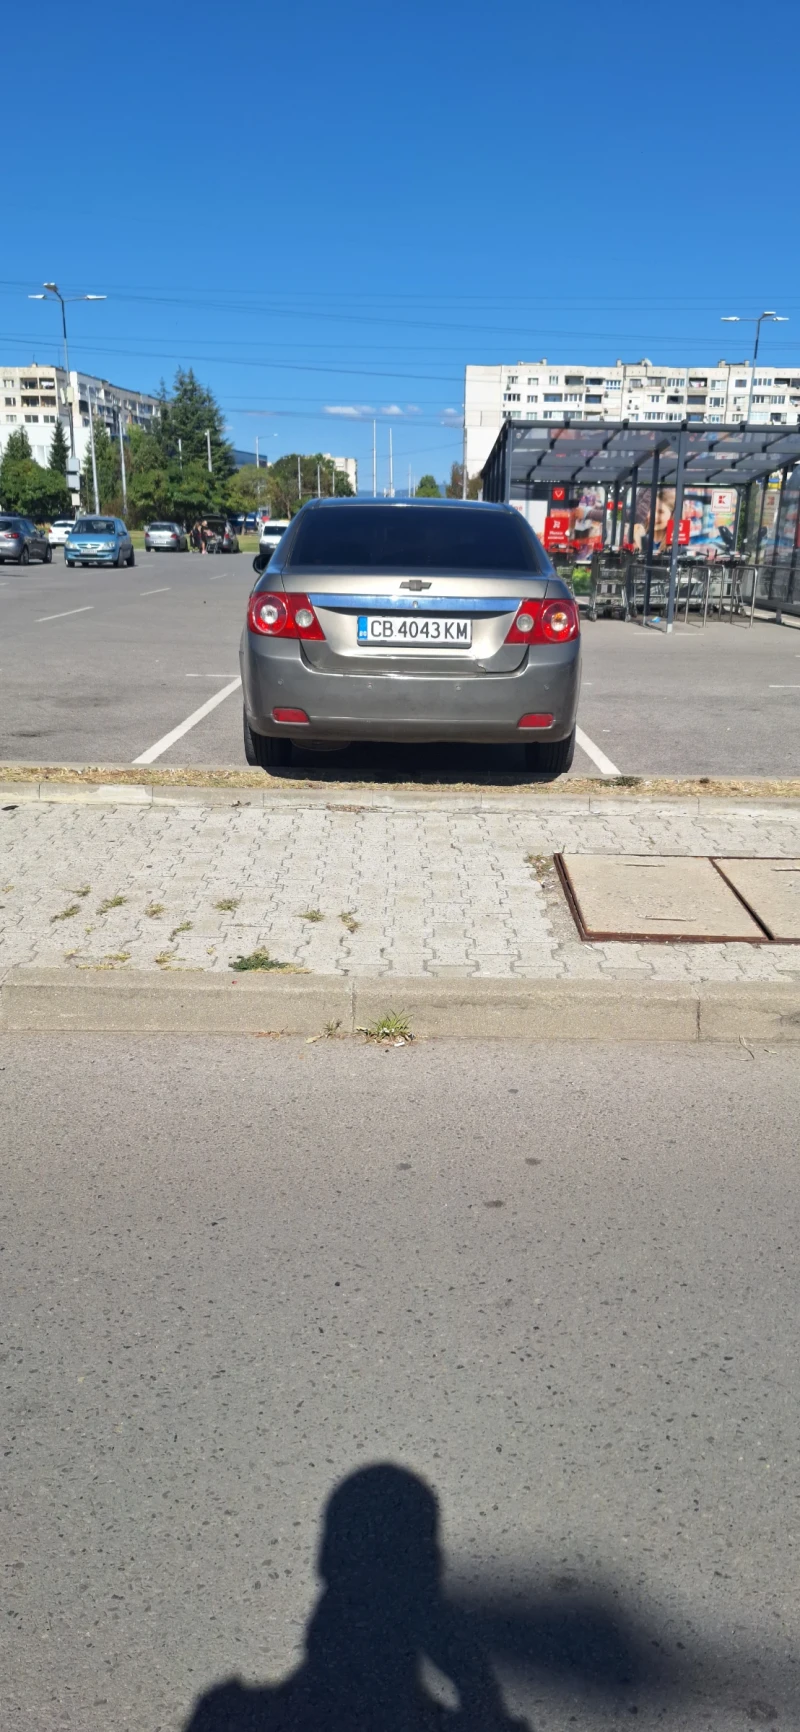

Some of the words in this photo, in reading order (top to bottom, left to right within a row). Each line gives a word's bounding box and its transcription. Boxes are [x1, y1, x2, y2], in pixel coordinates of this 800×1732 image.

[371, 620, 394, 638] CB
[398, 620, 441, 639] 4043
[444, 621, 468, 640] KM
